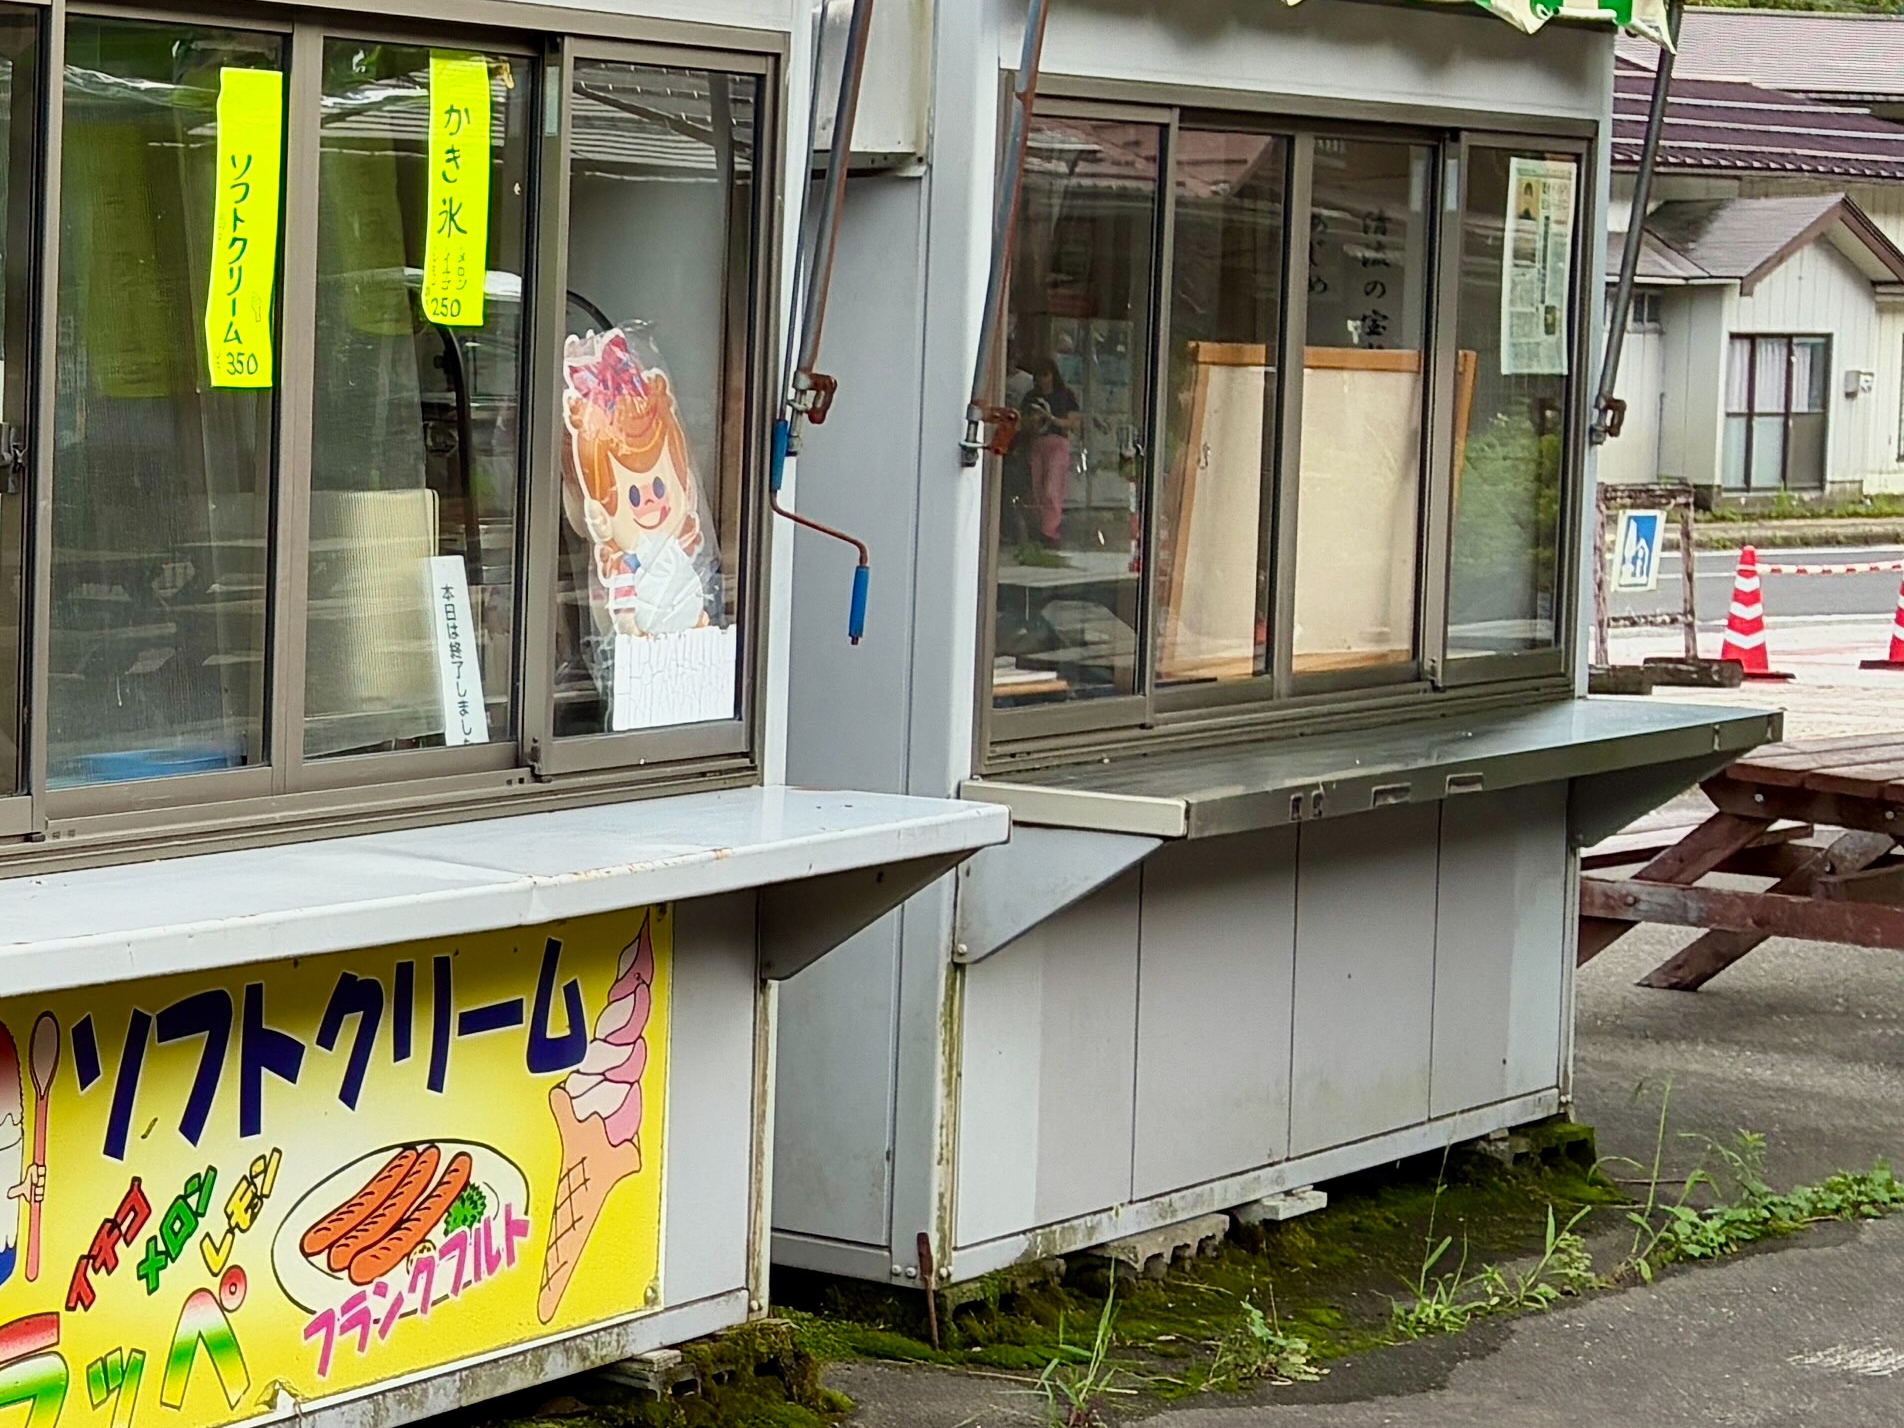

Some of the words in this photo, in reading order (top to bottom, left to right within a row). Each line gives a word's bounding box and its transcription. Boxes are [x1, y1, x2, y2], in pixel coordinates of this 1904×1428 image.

[437, 103, 471, 238] かき氷
[223, 154, 253, 344] ソフトクリーム
[430, 297, 462, 318] 250
[226, 352, 258, 376] 350
[440, 584, 473, 745] 本日は終了しまし
[69, 936, 589, 1161] ソフトクリーム
[64, 1175, 153, 1313] イチゴ
[136, 1164, 218, 1295] メロン
[201, 1147, 283, 1274] レモン
[302, 1203, 532, 1378] フランクフルト
